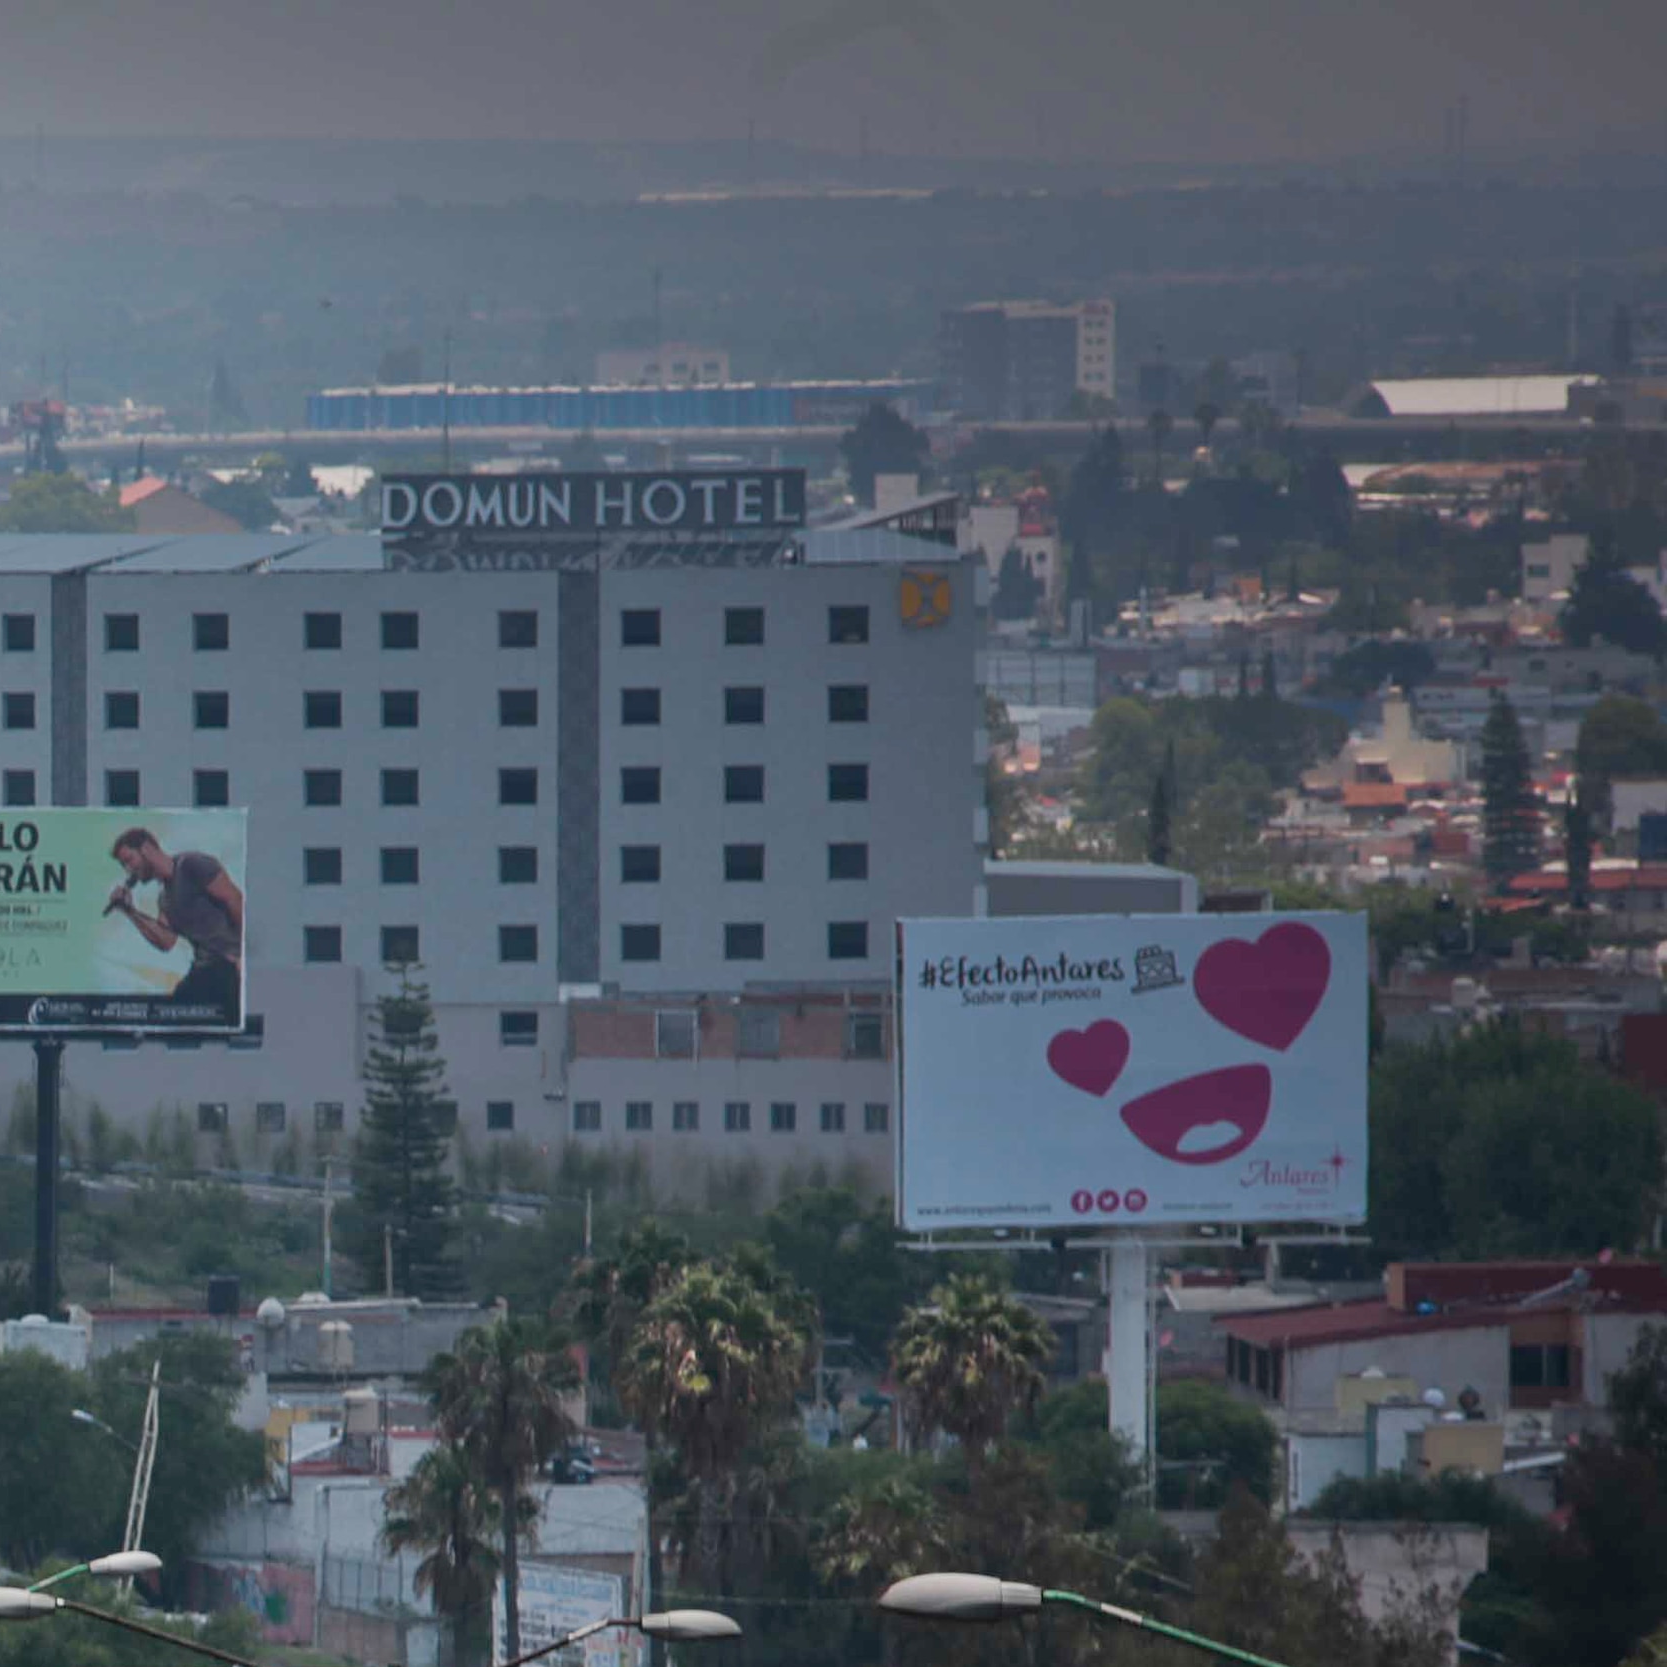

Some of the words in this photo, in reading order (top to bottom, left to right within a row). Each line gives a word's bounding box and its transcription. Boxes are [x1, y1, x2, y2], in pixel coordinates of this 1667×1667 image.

[381, 481, 571, 528] DOMUN
[595, 479, 801, 526] HOTEL
[919, 951, 1126, 990] #EfectoAntares
[961, 988, 1005, 1008] Sabor
[1009, 991, 1037, 1006] que
[1041, 987, 1101, 1006] provoca
[1240, 1160, 1330, 1189] Antares
